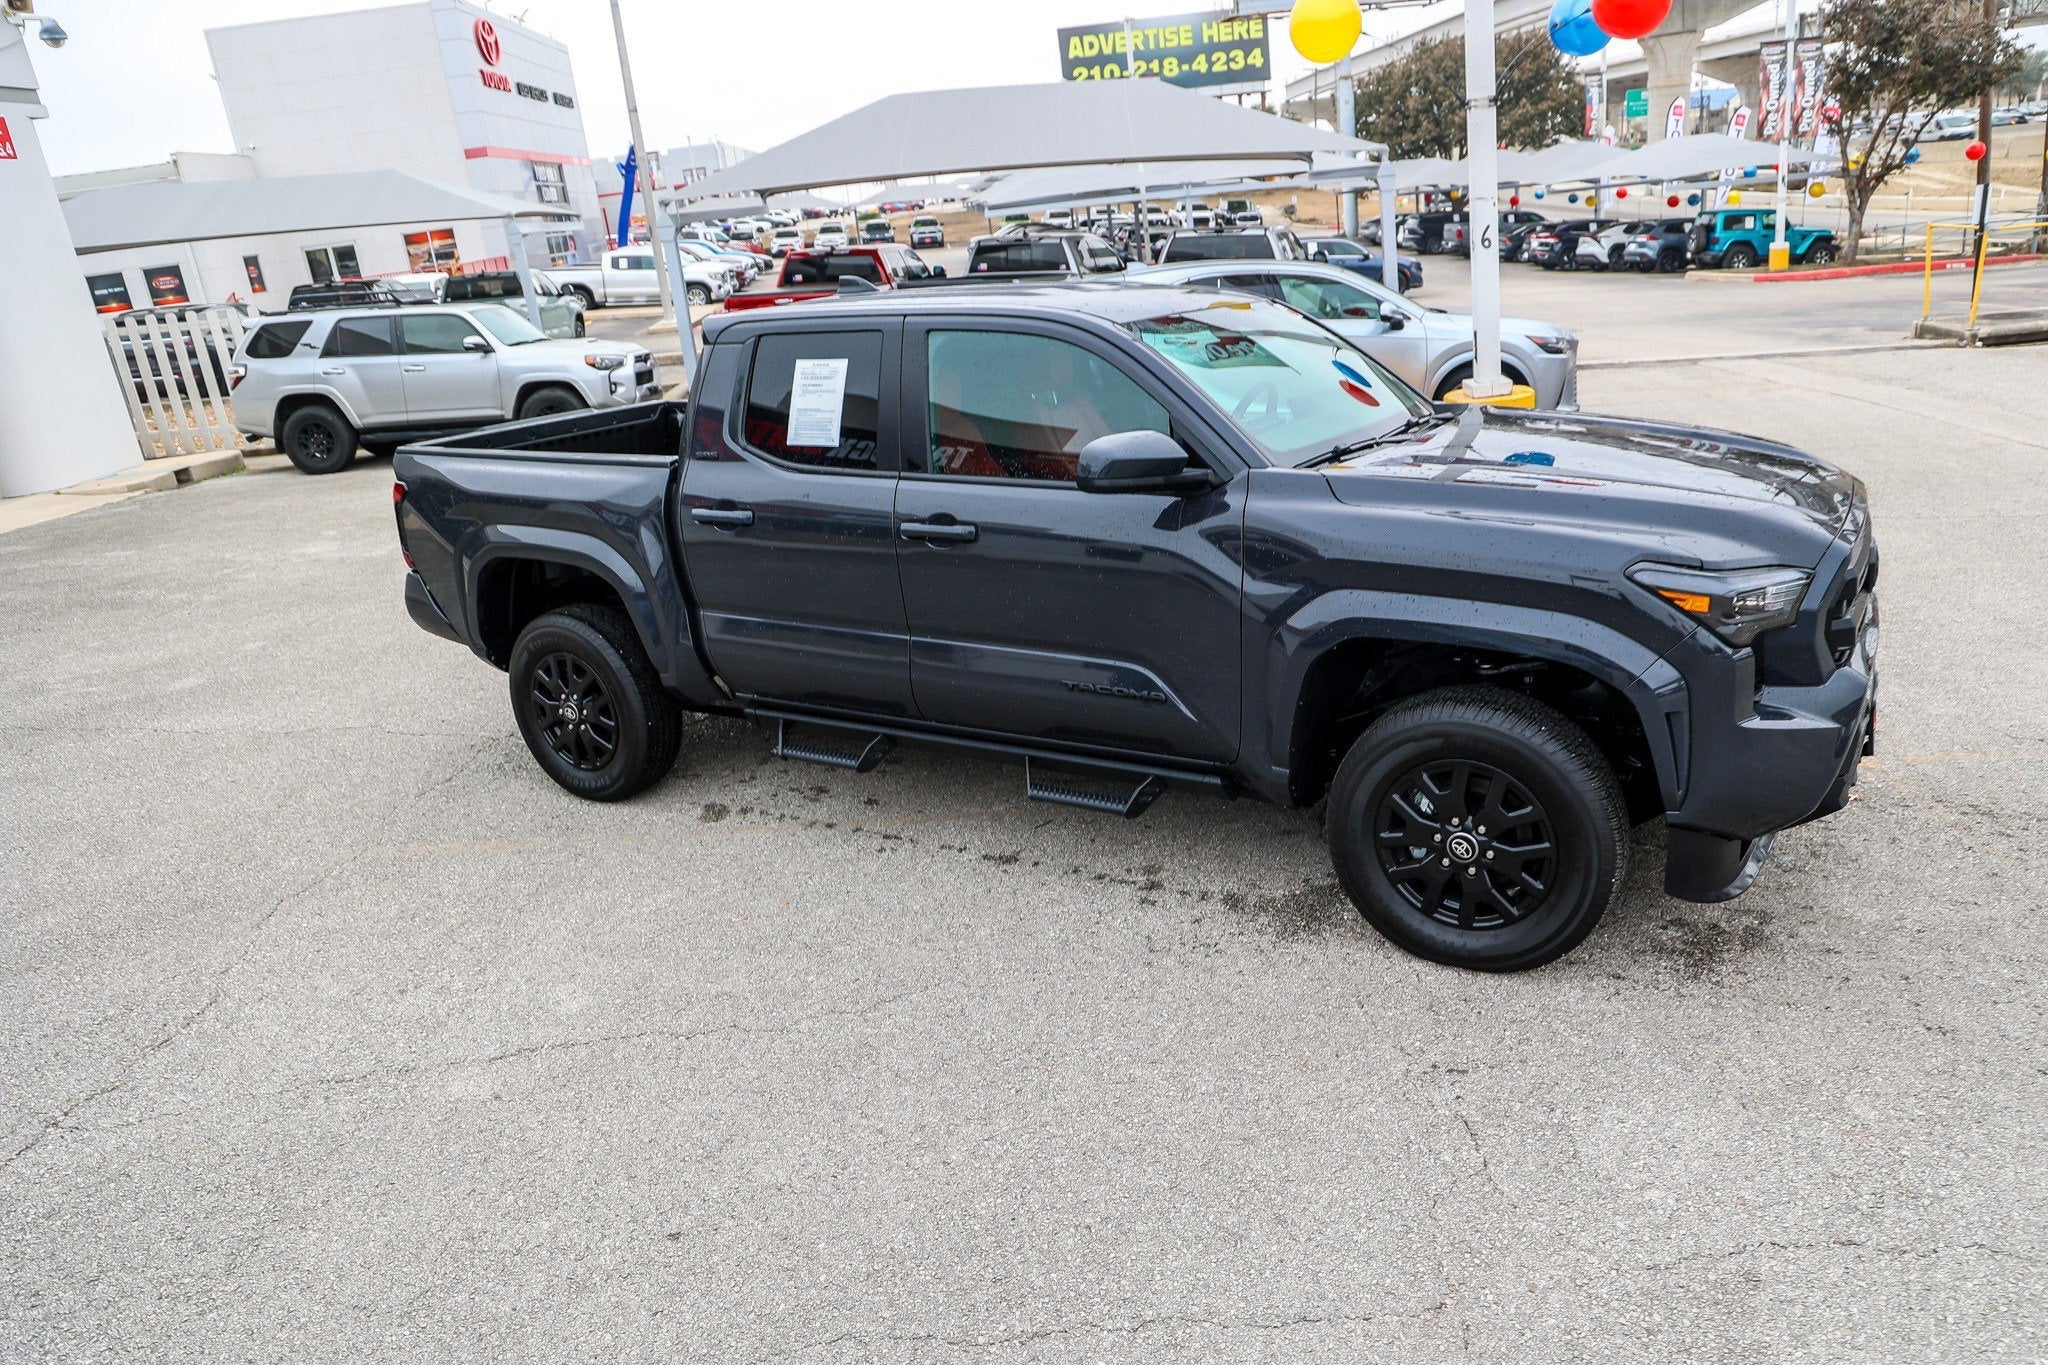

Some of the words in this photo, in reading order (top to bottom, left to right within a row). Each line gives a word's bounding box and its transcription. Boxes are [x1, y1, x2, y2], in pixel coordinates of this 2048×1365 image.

[1068, 24, 1193, 59] ADVERTISE
[1202, 17, 1264, 44] HERE
[479, 68, 513, 93] TOYOTA
[1072, 47, 1264, 81] 210-218-4234
[1763, 63, 1781, 135] Pre-Owned
[1798, 60, 1816, 133] Pre-Owned
[1480, 224, 1492, 249] 6
[1060, 679, 1168, 704] TACOMA
